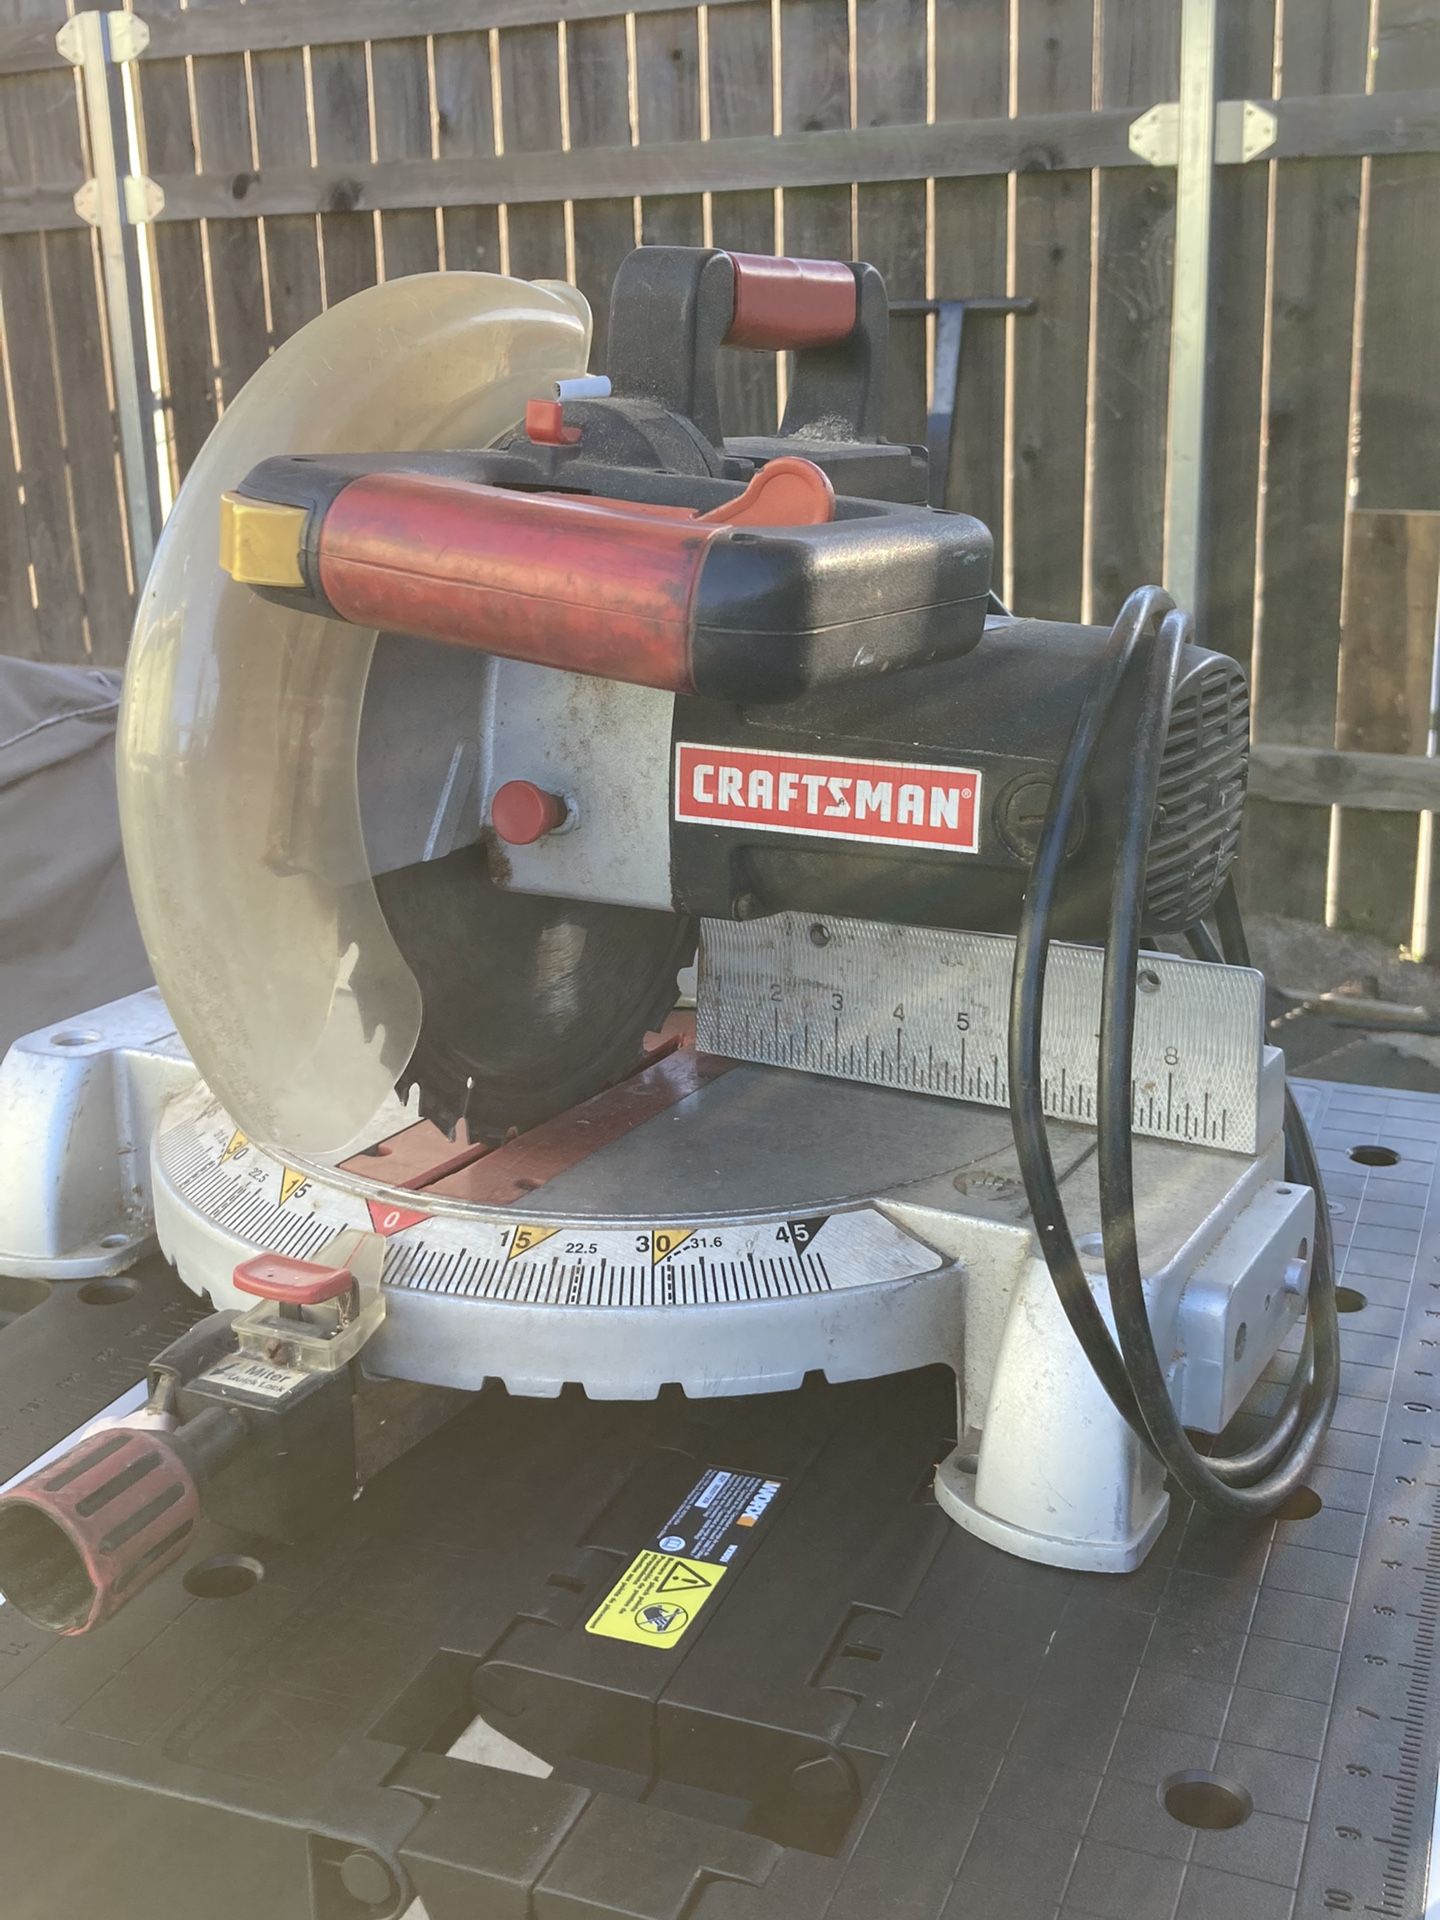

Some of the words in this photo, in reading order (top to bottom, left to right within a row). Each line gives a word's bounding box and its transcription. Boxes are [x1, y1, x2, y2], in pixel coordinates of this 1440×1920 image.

[693, 764, 959, 829] CRAFTSMAN
[770, 984, 782, 1002] 2
[831, 993, 844, 1011] 3
[892, 1003, 905, 1021] 4
[956, 1012, 970, 1031] 5
[1164, 1046, 1179, 1066] 8
[285, 1178, 312, 1199] 15
[383, 1210, 400, 1227] 0
[499, 1231, 532, 1250] 15
[690, 1236, 723, 1249] 31.6
[775, 1223, 810, 1244] 45
[565, 1242, 598, 1254] 22.5
[635, 1235, 671, 1253] 30
[245, 1365, 291, 1382] Miter
[1403, 1401, 1432, 1413] 0
[1395, 1475, 1416, 1486] 2
[740, 1480, 782, 1520] WORX
[1324, 1887, 1353, 1911] 10
